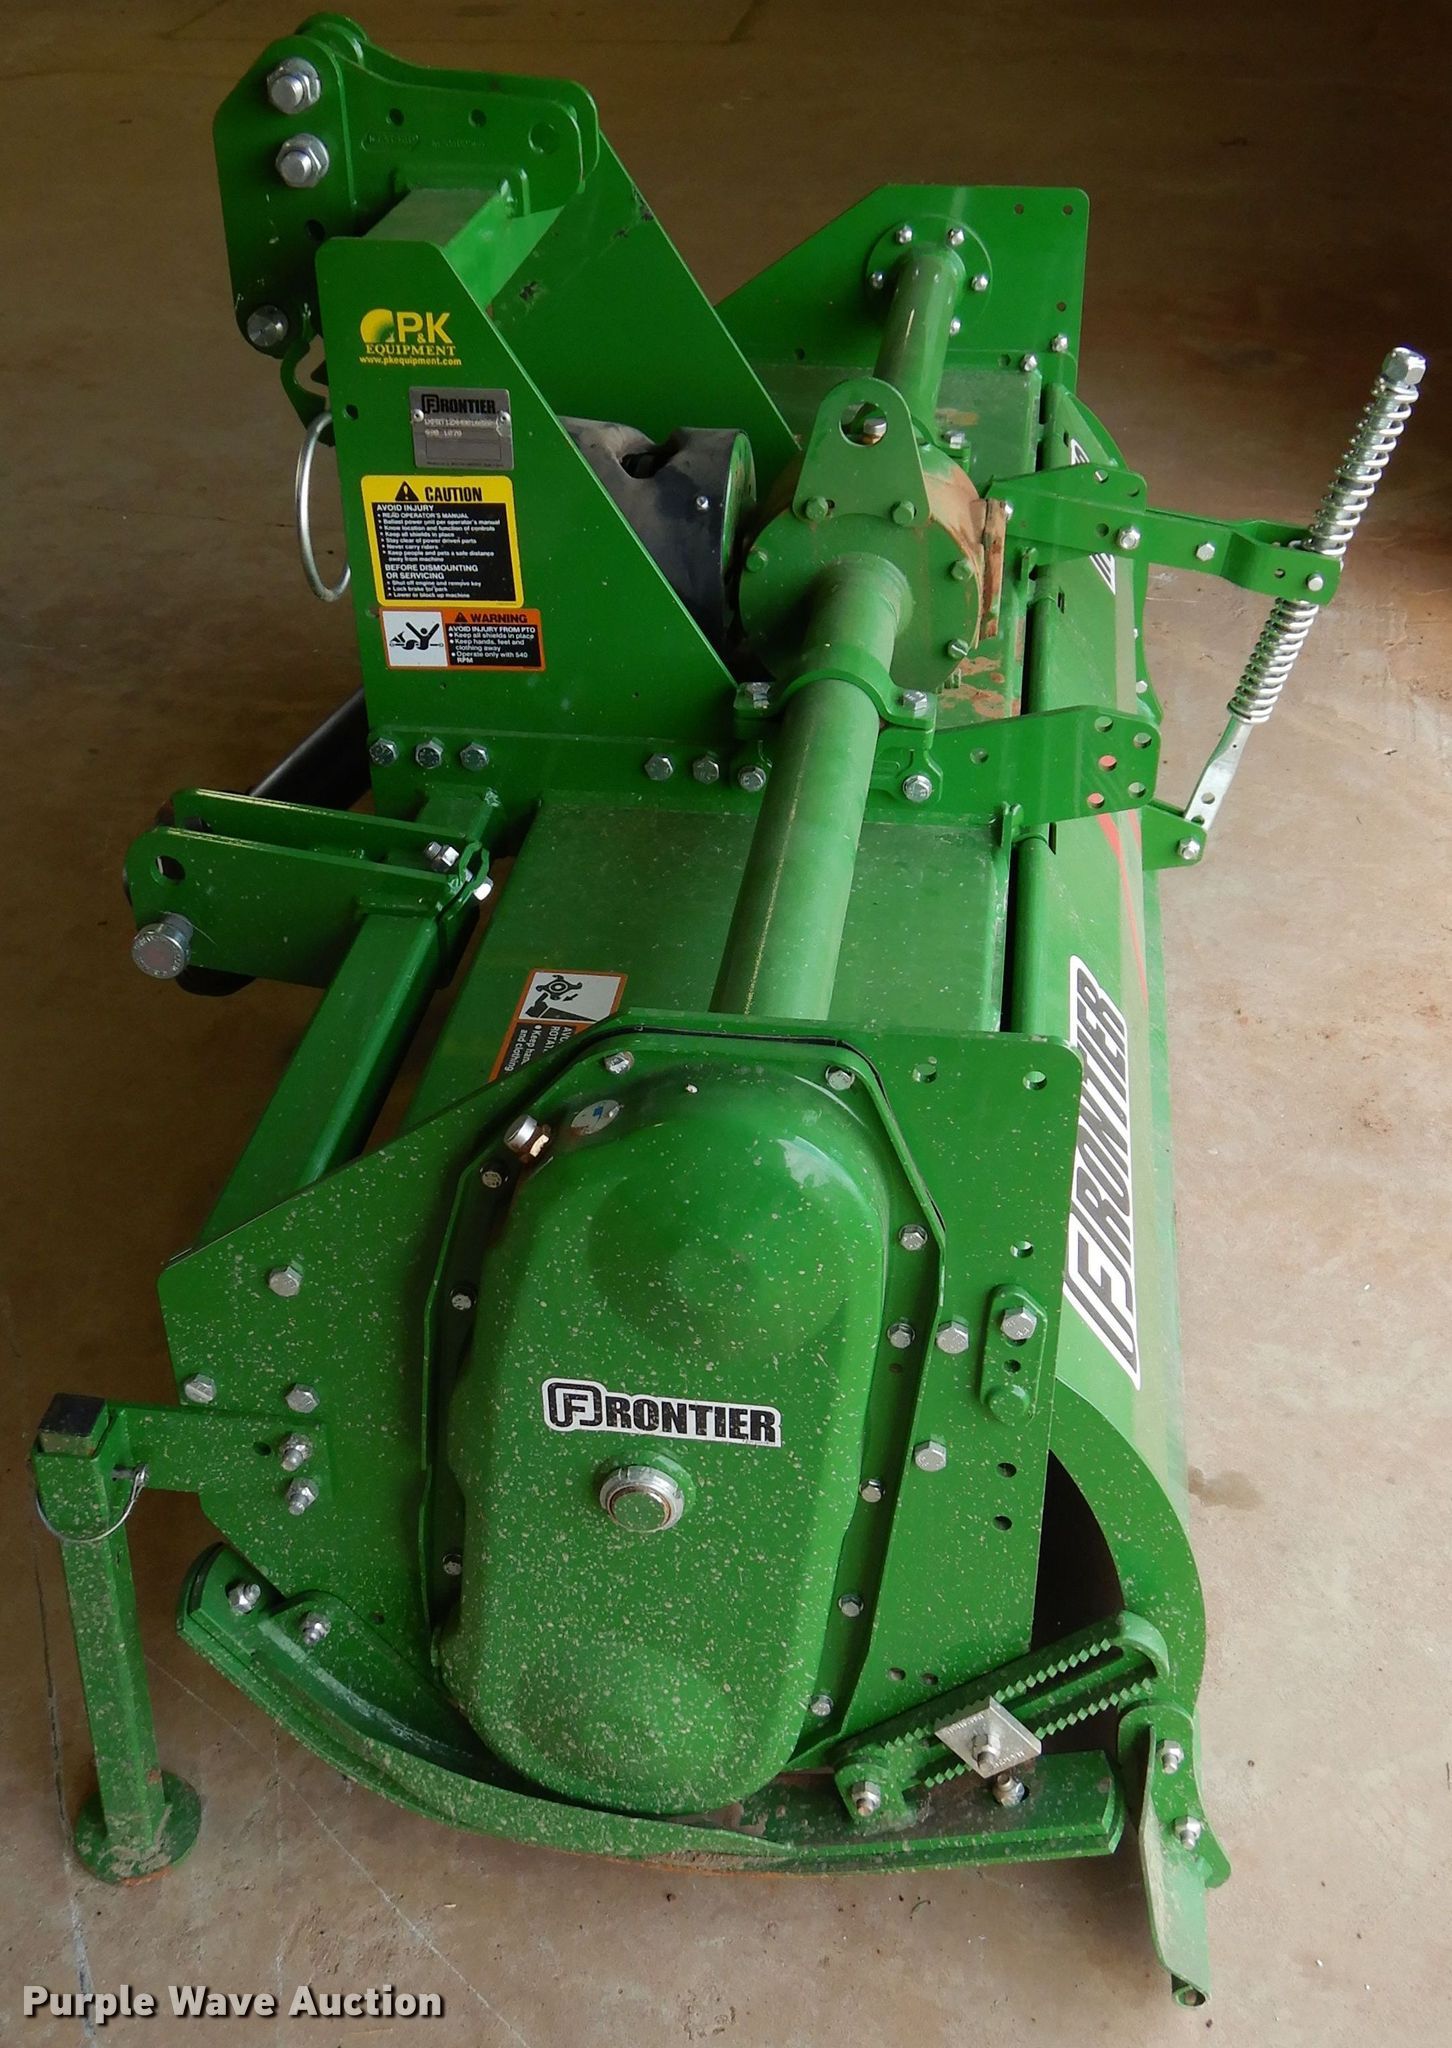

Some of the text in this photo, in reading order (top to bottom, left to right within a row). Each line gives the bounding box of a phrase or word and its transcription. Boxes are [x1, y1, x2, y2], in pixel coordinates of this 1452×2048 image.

[366, 344, 456, 356] EQUIPMENT
[359, 355, 462, 366] www.pkequipment.com
[421, 394, 496, 414] FRONTIER
[424, 486, 483, 502] CAUTION
[385, 564, 479, 572] BEFORE DISMOUNTING
[470, 614, 528, 624] WARNING
[456, 652, 484, 660] Operate
[484, 652, 500, 660] only
[526, 1030, 542, 1048] Keep
[504, 1029, 528, 1072] and clothing
[547, 1382, 776, 1443] FRONTIER
